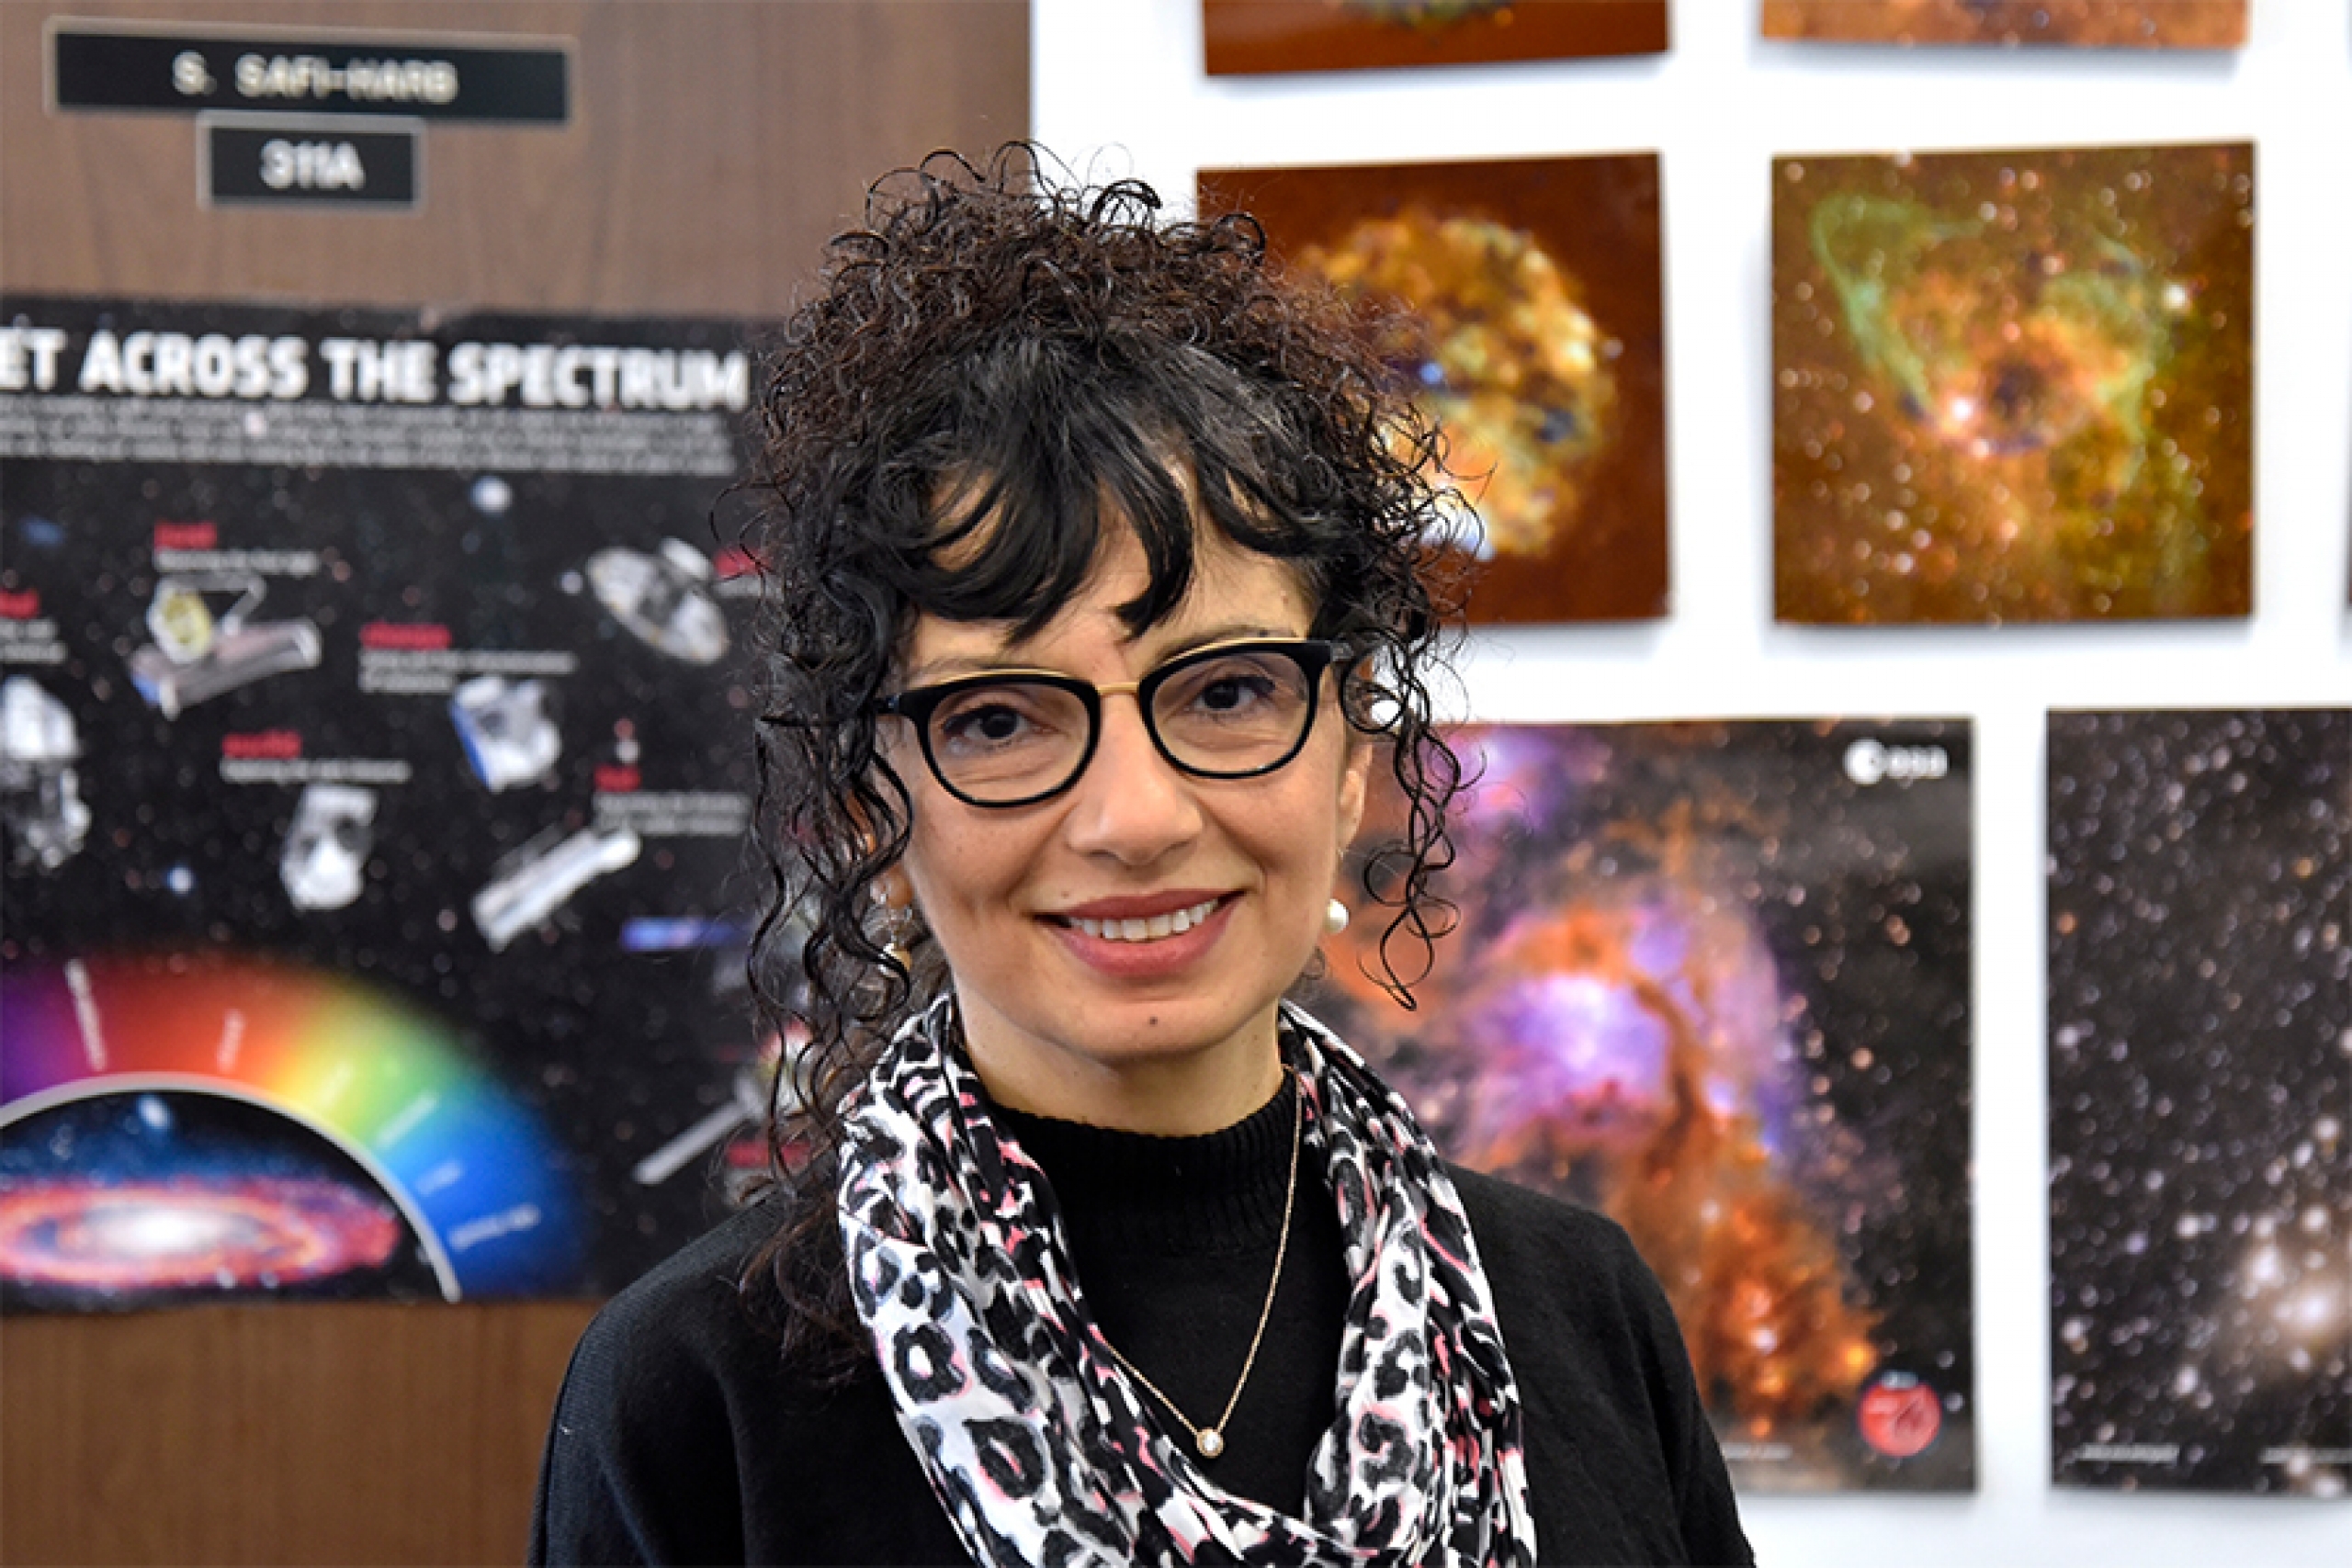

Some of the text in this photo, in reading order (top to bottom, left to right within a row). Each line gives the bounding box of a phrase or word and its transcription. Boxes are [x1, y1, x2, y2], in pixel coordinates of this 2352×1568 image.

[173, 51, 216, 96] S.
[260, 139, 366, 189] 311A
[79, 330, 310, 399] ACROSS
[320, 337, 436, 403] THE
[448, 342, 750, 411] SPECTRUM
